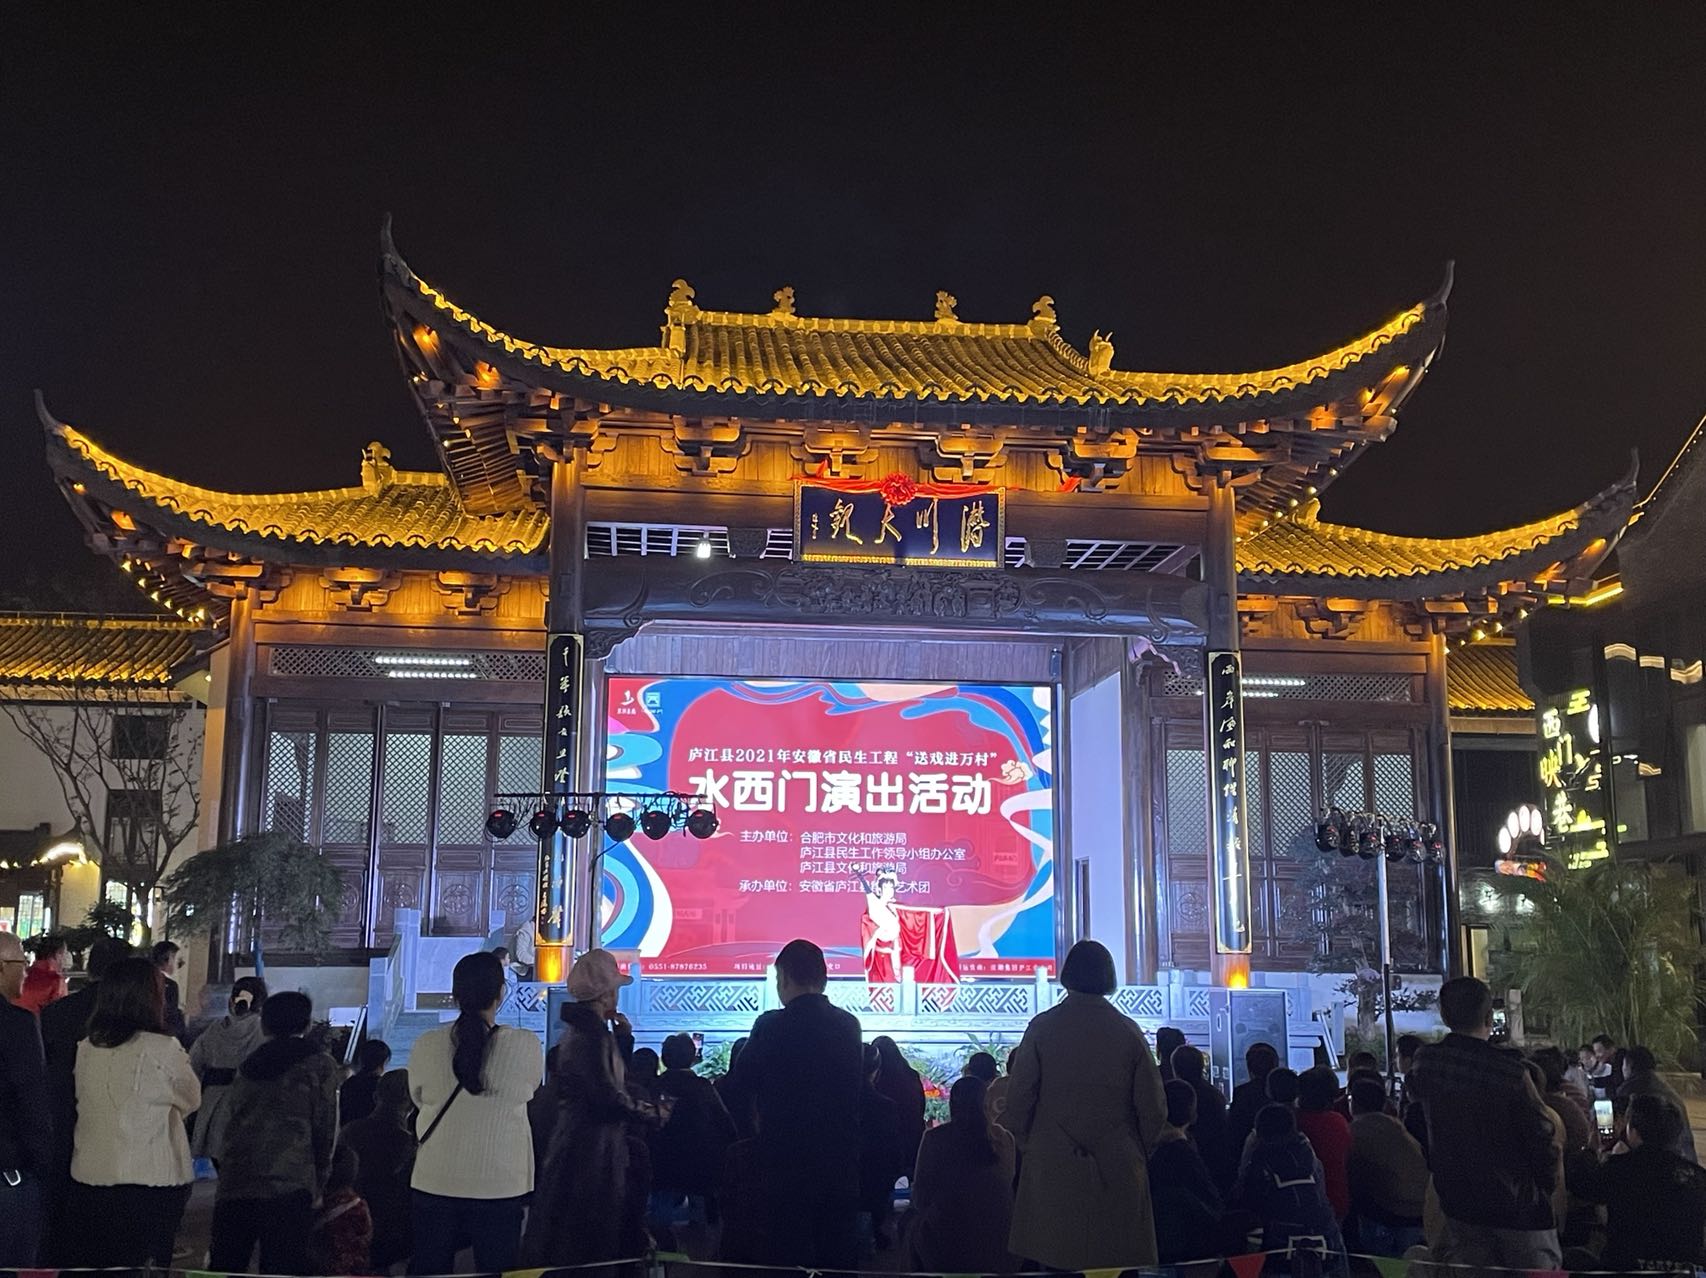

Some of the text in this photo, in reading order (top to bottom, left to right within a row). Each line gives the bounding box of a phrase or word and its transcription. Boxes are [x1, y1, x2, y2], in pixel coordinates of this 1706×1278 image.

[687, 747, 898, 765] 庐江县2021年安徽省民生工程
[688, 767, 992, 816] 水西门演出活动
[800, 832, 908, 845] 合肥市文化和旅游局
[800, 846, 966, 861] 庐江县民生工作领导小组办公室
[799, 880, 931, 894] 安徽省庐江艺术团
